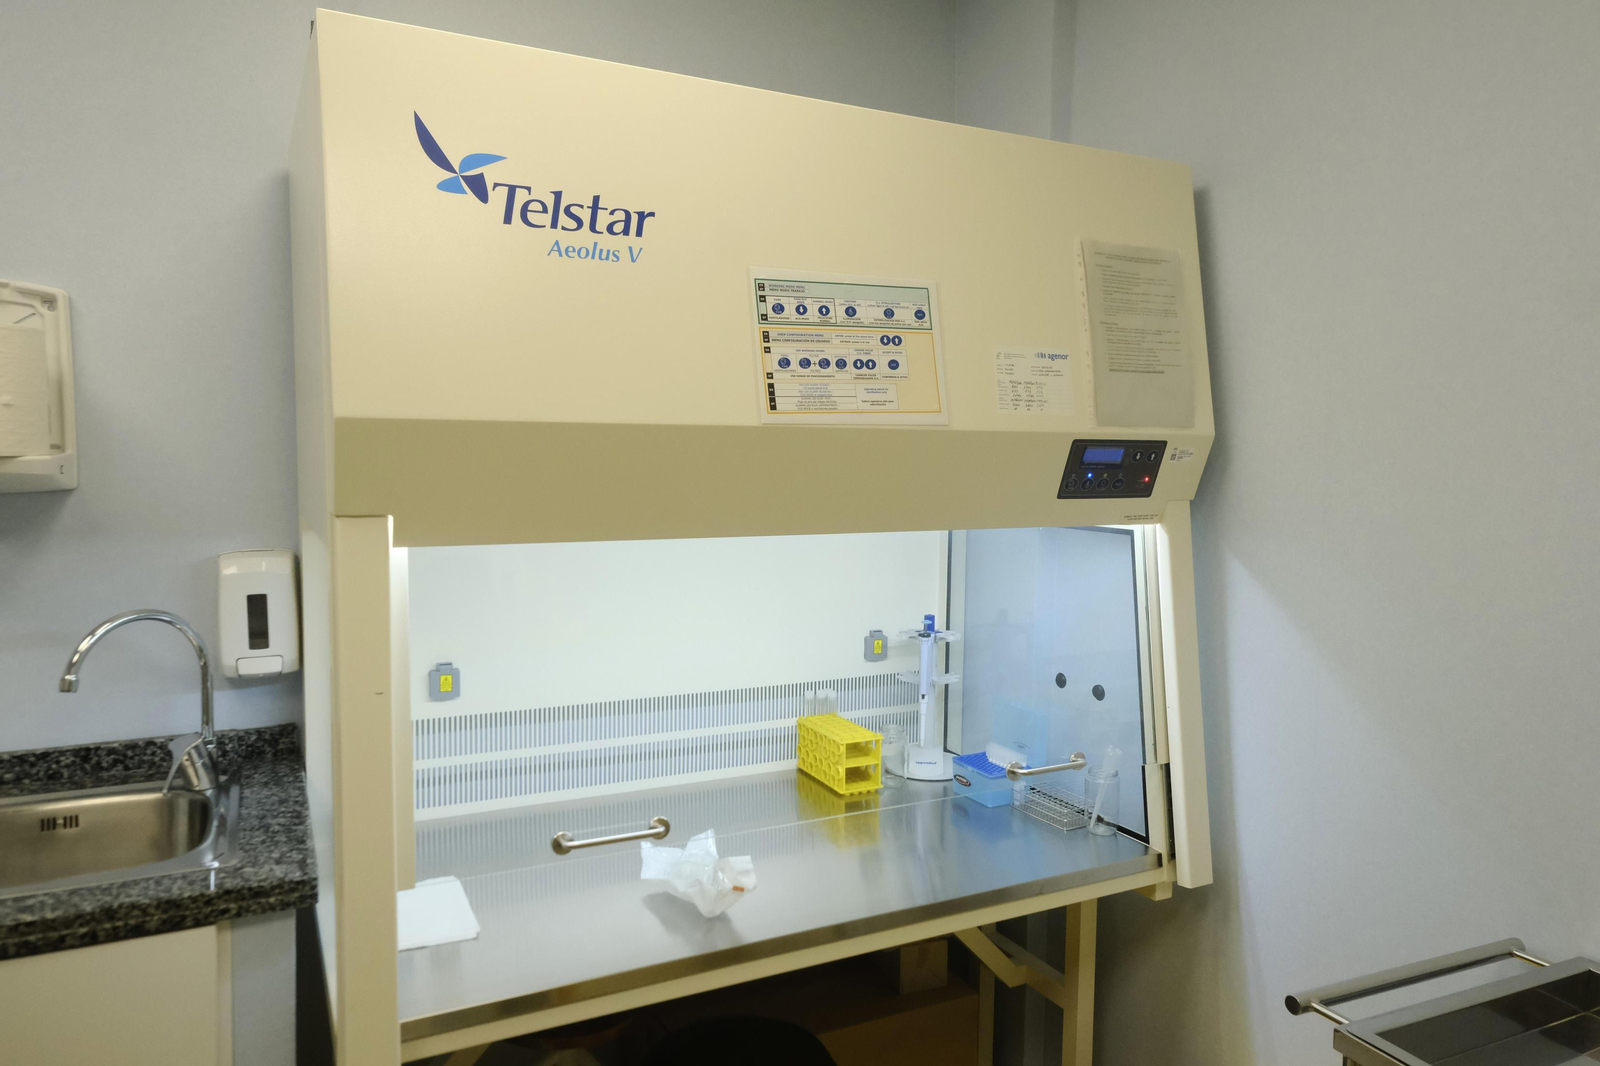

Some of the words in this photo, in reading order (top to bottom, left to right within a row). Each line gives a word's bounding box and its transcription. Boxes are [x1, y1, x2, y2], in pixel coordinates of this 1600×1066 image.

[492, 182, 656, 238] Telstar
[547, 239, 621, 263] Aeolus
[628, 246, 643, 263] V
[1048, 353, 1069, 361] agenor
